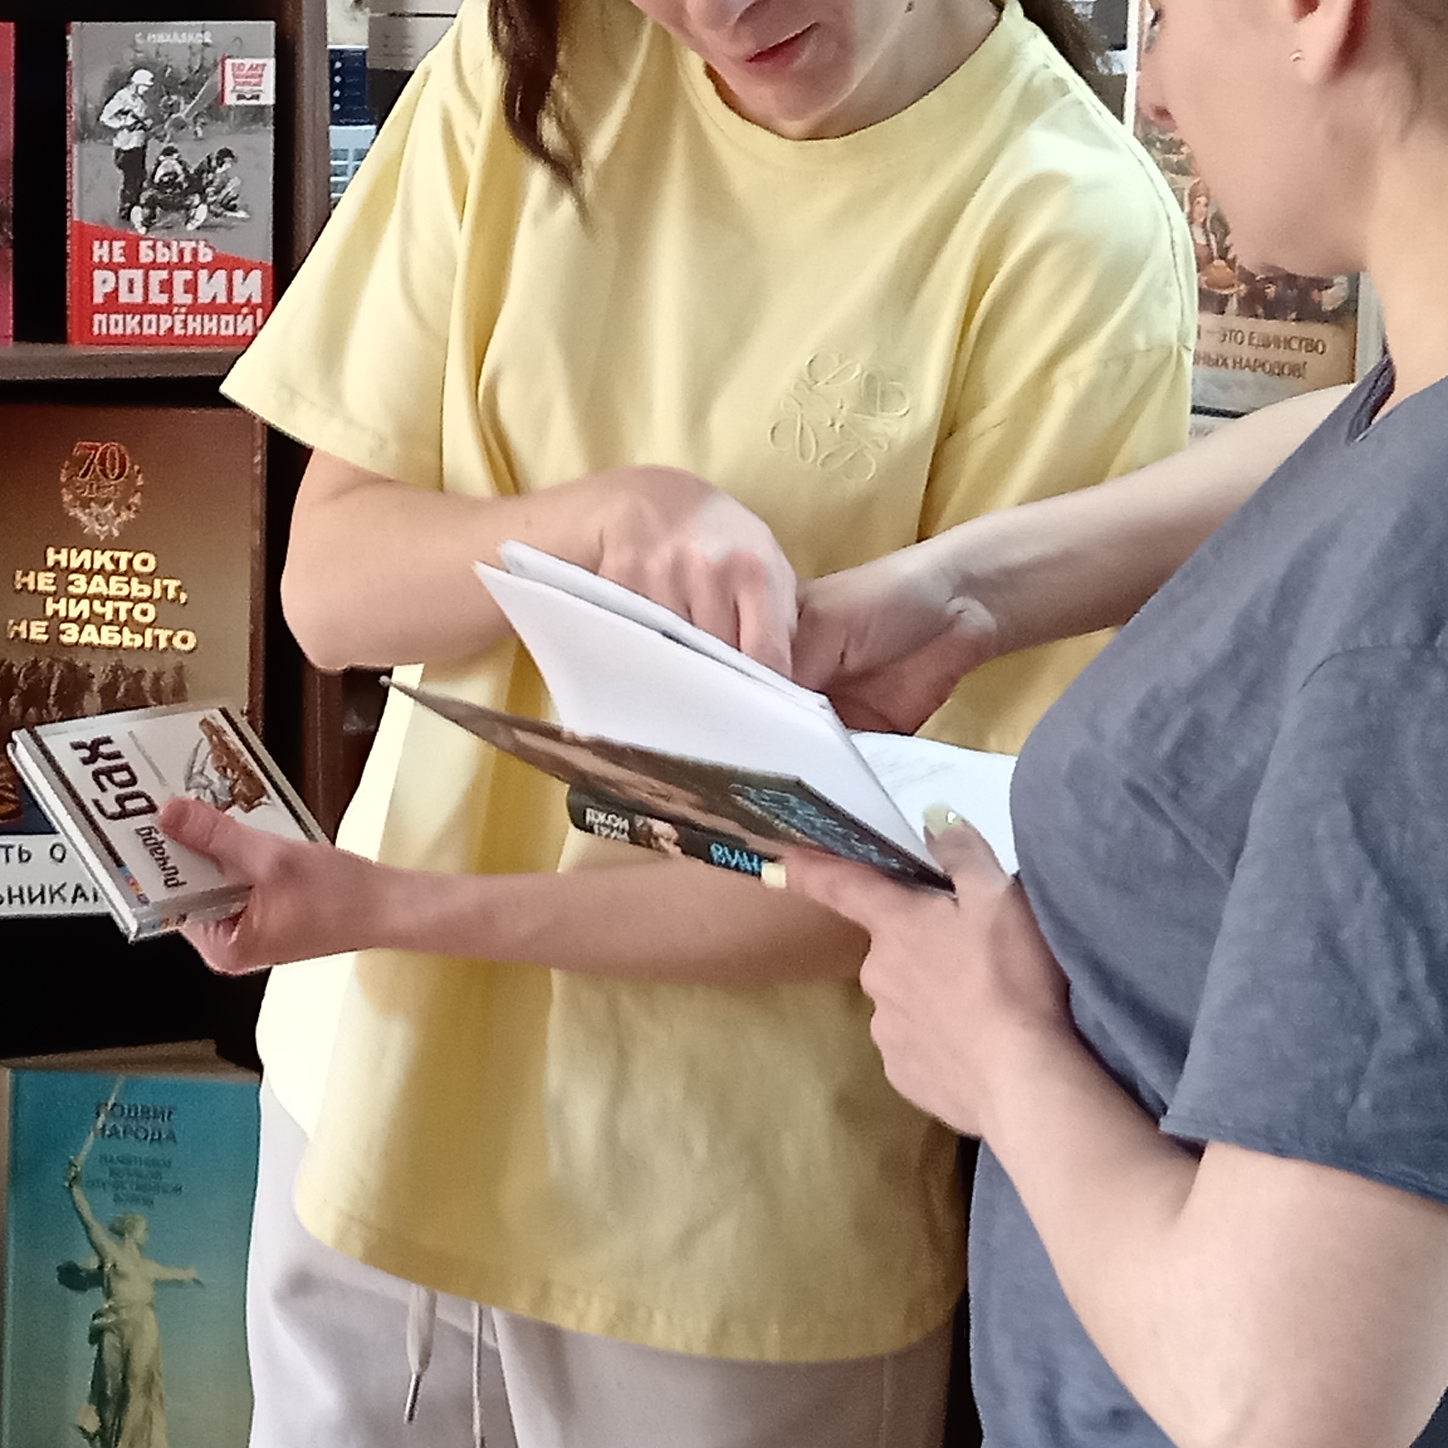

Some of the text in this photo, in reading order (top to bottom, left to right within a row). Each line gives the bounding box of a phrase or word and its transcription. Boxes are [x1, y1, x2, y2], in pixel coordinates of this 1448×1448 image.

[93, 240, 214, 263] НЕ БЫТЬ
[93, 269, 263, 304] РОССИИ
[93, 306, 264, 336] ПОКОРЁННОЙ!
[1248, 330, 1326, 355] ЕДИНСТВО
[72, 441, 130, 481] 70
[46, 547, 156, 574] НИКТО
[14, 570, 187, 604] НЕ ЗАБЫТ,
[45, 598, 156, 623] НИЧТО
[8, 619, 197, 652] НЕ ЗАБЫТО
[49, 842, 67, 862] О
